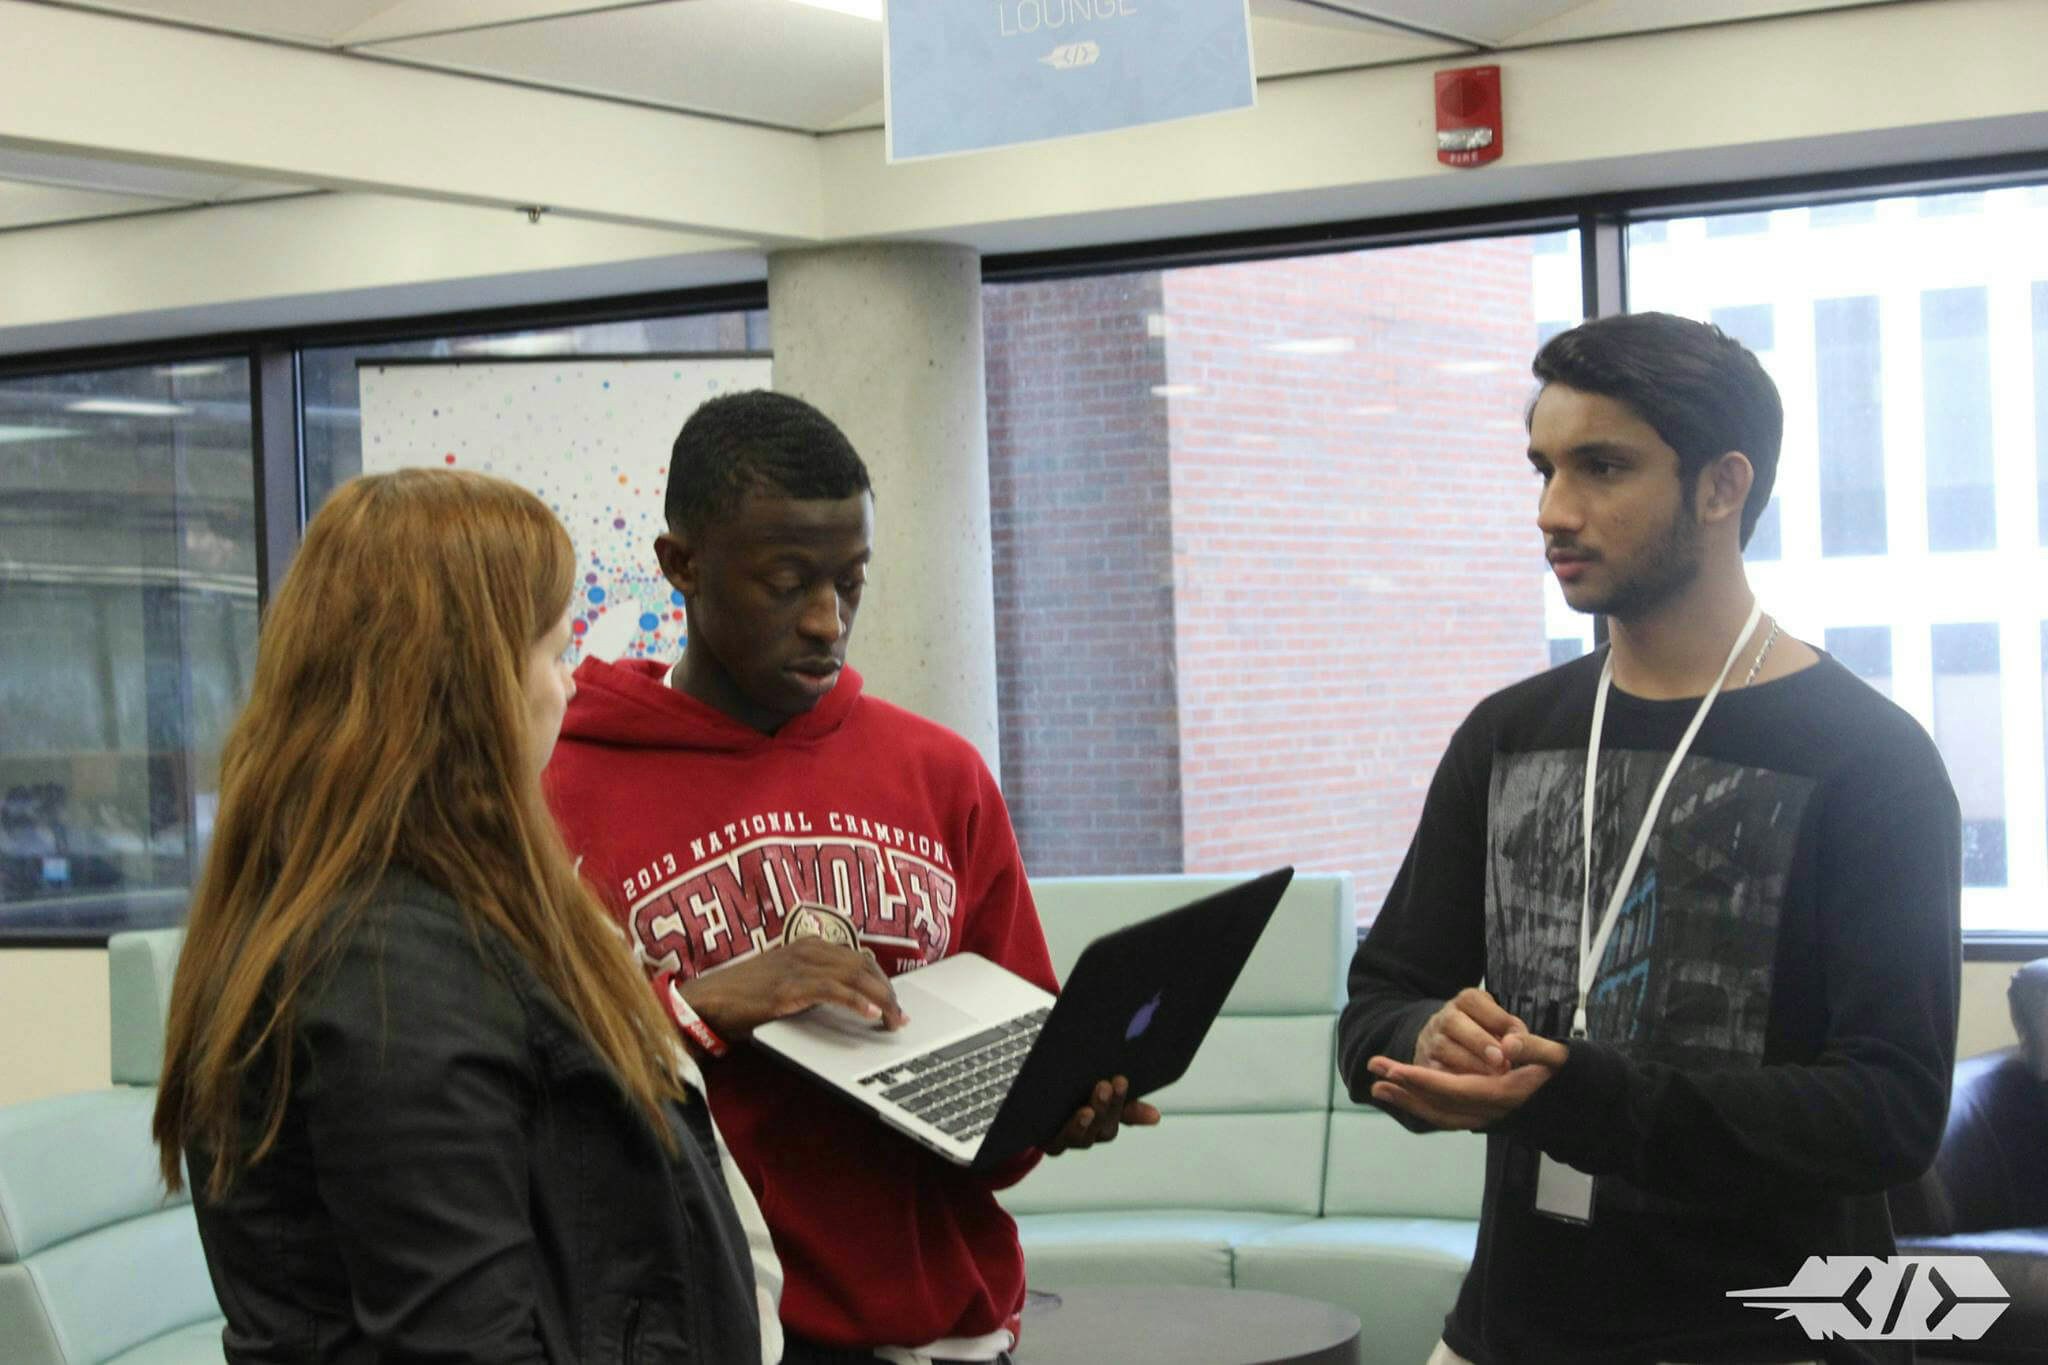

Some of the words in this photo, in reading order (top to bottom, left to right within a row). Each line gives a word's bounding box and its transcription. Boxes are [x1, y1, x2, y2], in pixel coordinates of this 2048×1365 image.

[1449, 151, 1479, 164] FIRE
[622, 852, 678, 901] 2013
[690, 811, 812, 860] NATIONAL
